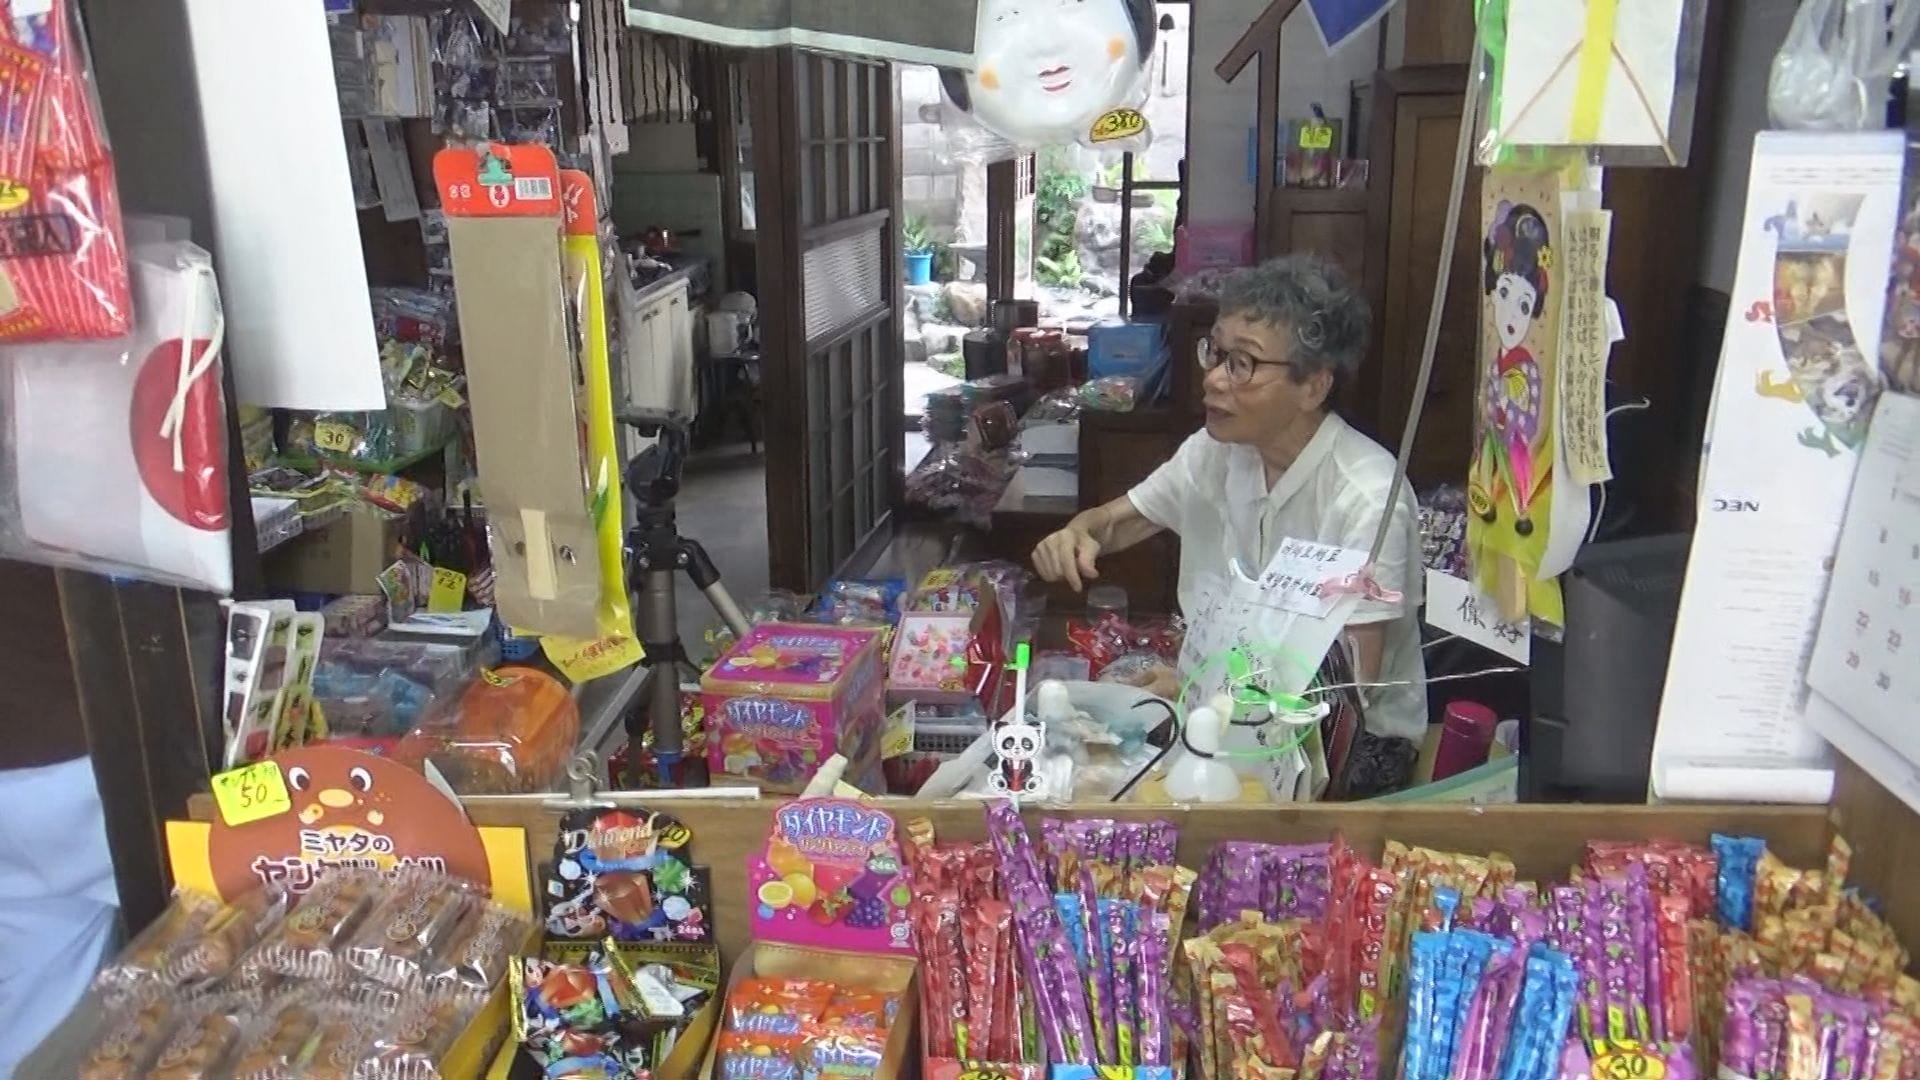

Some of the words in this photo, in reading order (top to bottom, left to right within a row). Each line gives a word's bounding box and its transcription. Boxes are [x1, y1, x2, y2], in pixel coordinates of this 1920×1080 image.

[322, 430, 345, 446] 30
[1712, 498, 1761, 512] NEC
[240, 783, 269, 809] 50
[782, 806, 887, 840] ダイヤモンド
[302, 830, 393, 854] ミヤタの
[1610, 1054, 1648, 1080] 30
